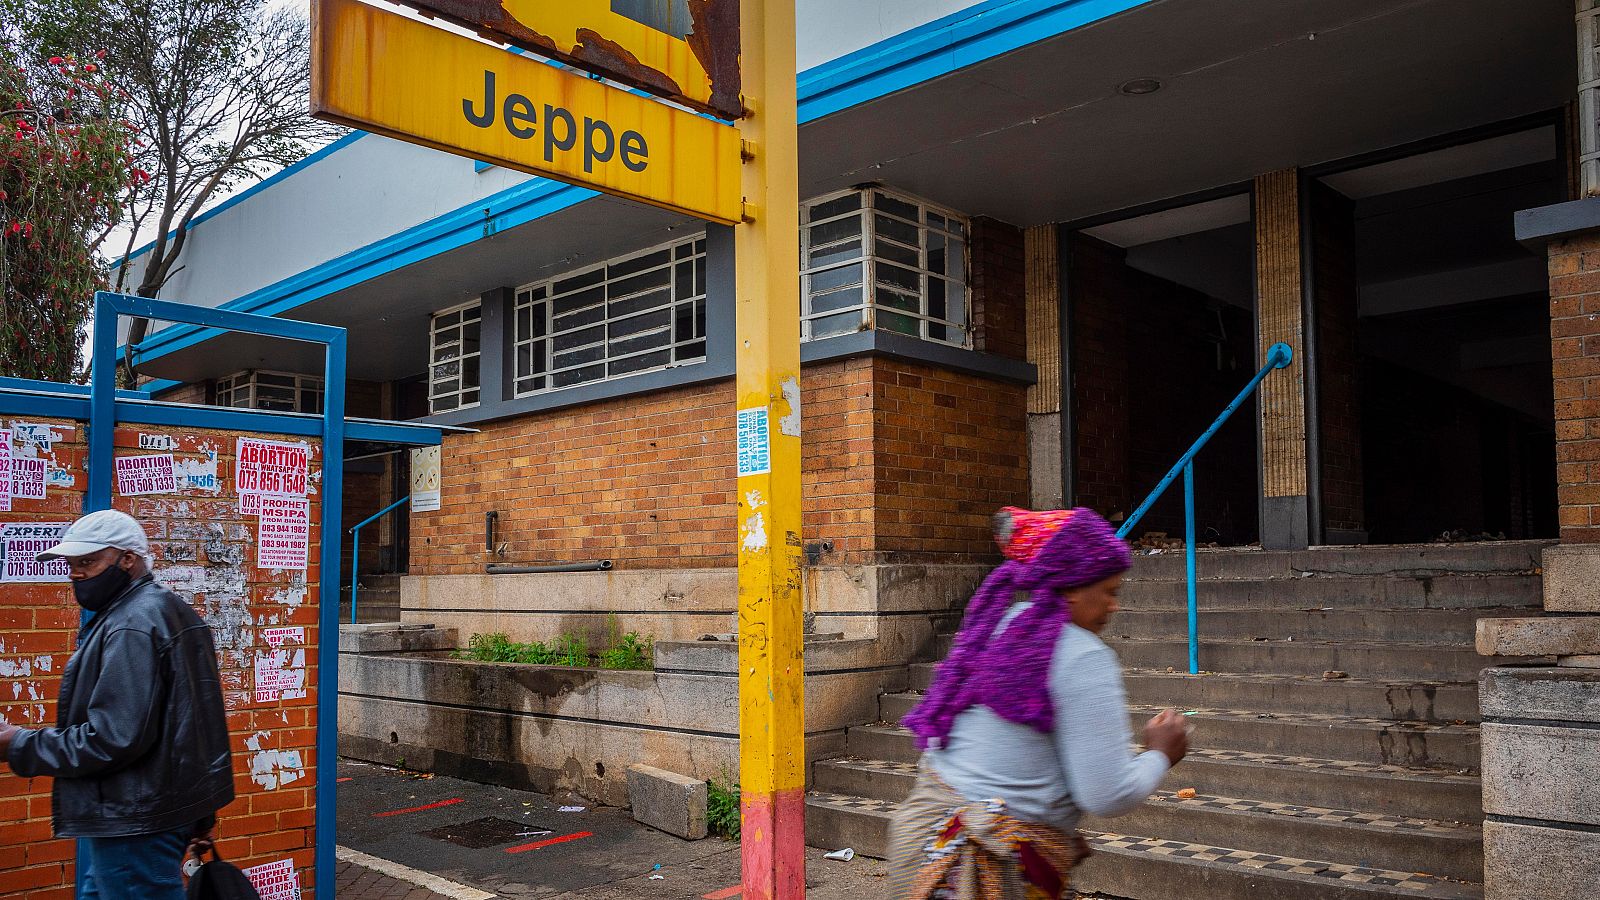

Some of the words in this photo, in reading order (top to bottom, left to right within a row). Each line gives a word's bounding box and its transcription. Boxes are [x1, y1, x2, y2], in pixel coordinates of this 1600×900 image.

[462, 69, 649, 173] Jeppe
[738, 412, 748, 429] 078
[738, 430, 749, 449] 508
[757, 410, 769, 471] ABORTION
[276, 445, 305, 453] MINUTES
[118, 456, 172, 470] ABORTION
[240, 446, 307, 468] ABORTION
[738, 450, 749, 473] 1333
[21, 481, 44, 496] 1333
[120, 479, 136, 494] 078
[138, 478, 154, 492] 508
[155, 476, 175, 491] 1333
[239, 470, 257, 490] 073
[260, 471, 280, 492] 856
[282, 473, 305, 494] 1548
[242, 494, 255, 508] 073
[262, 499, 308, 509] PROPHET
[262, 508, 307, 519] MSIPA
[4, 527, 62, 537] EXPERT
[262, 524, 276, 532] 083
[276, 525, 289, 533] 944
[290, 526, 307, 534] 1982
[261, 539, 275, 548] 083
[276, 540, 289, 548] 944
[290, 541, 306, 549] 1982
[8, 562, 25, 576] 078
[27, 562, 45, 576] 508
[47, 561, 69, 576] 1333
[257, 690, 270, 701] 073
[250, 862, 286, 874] HERBALIST
[275, 881, 293, 893] 8783
